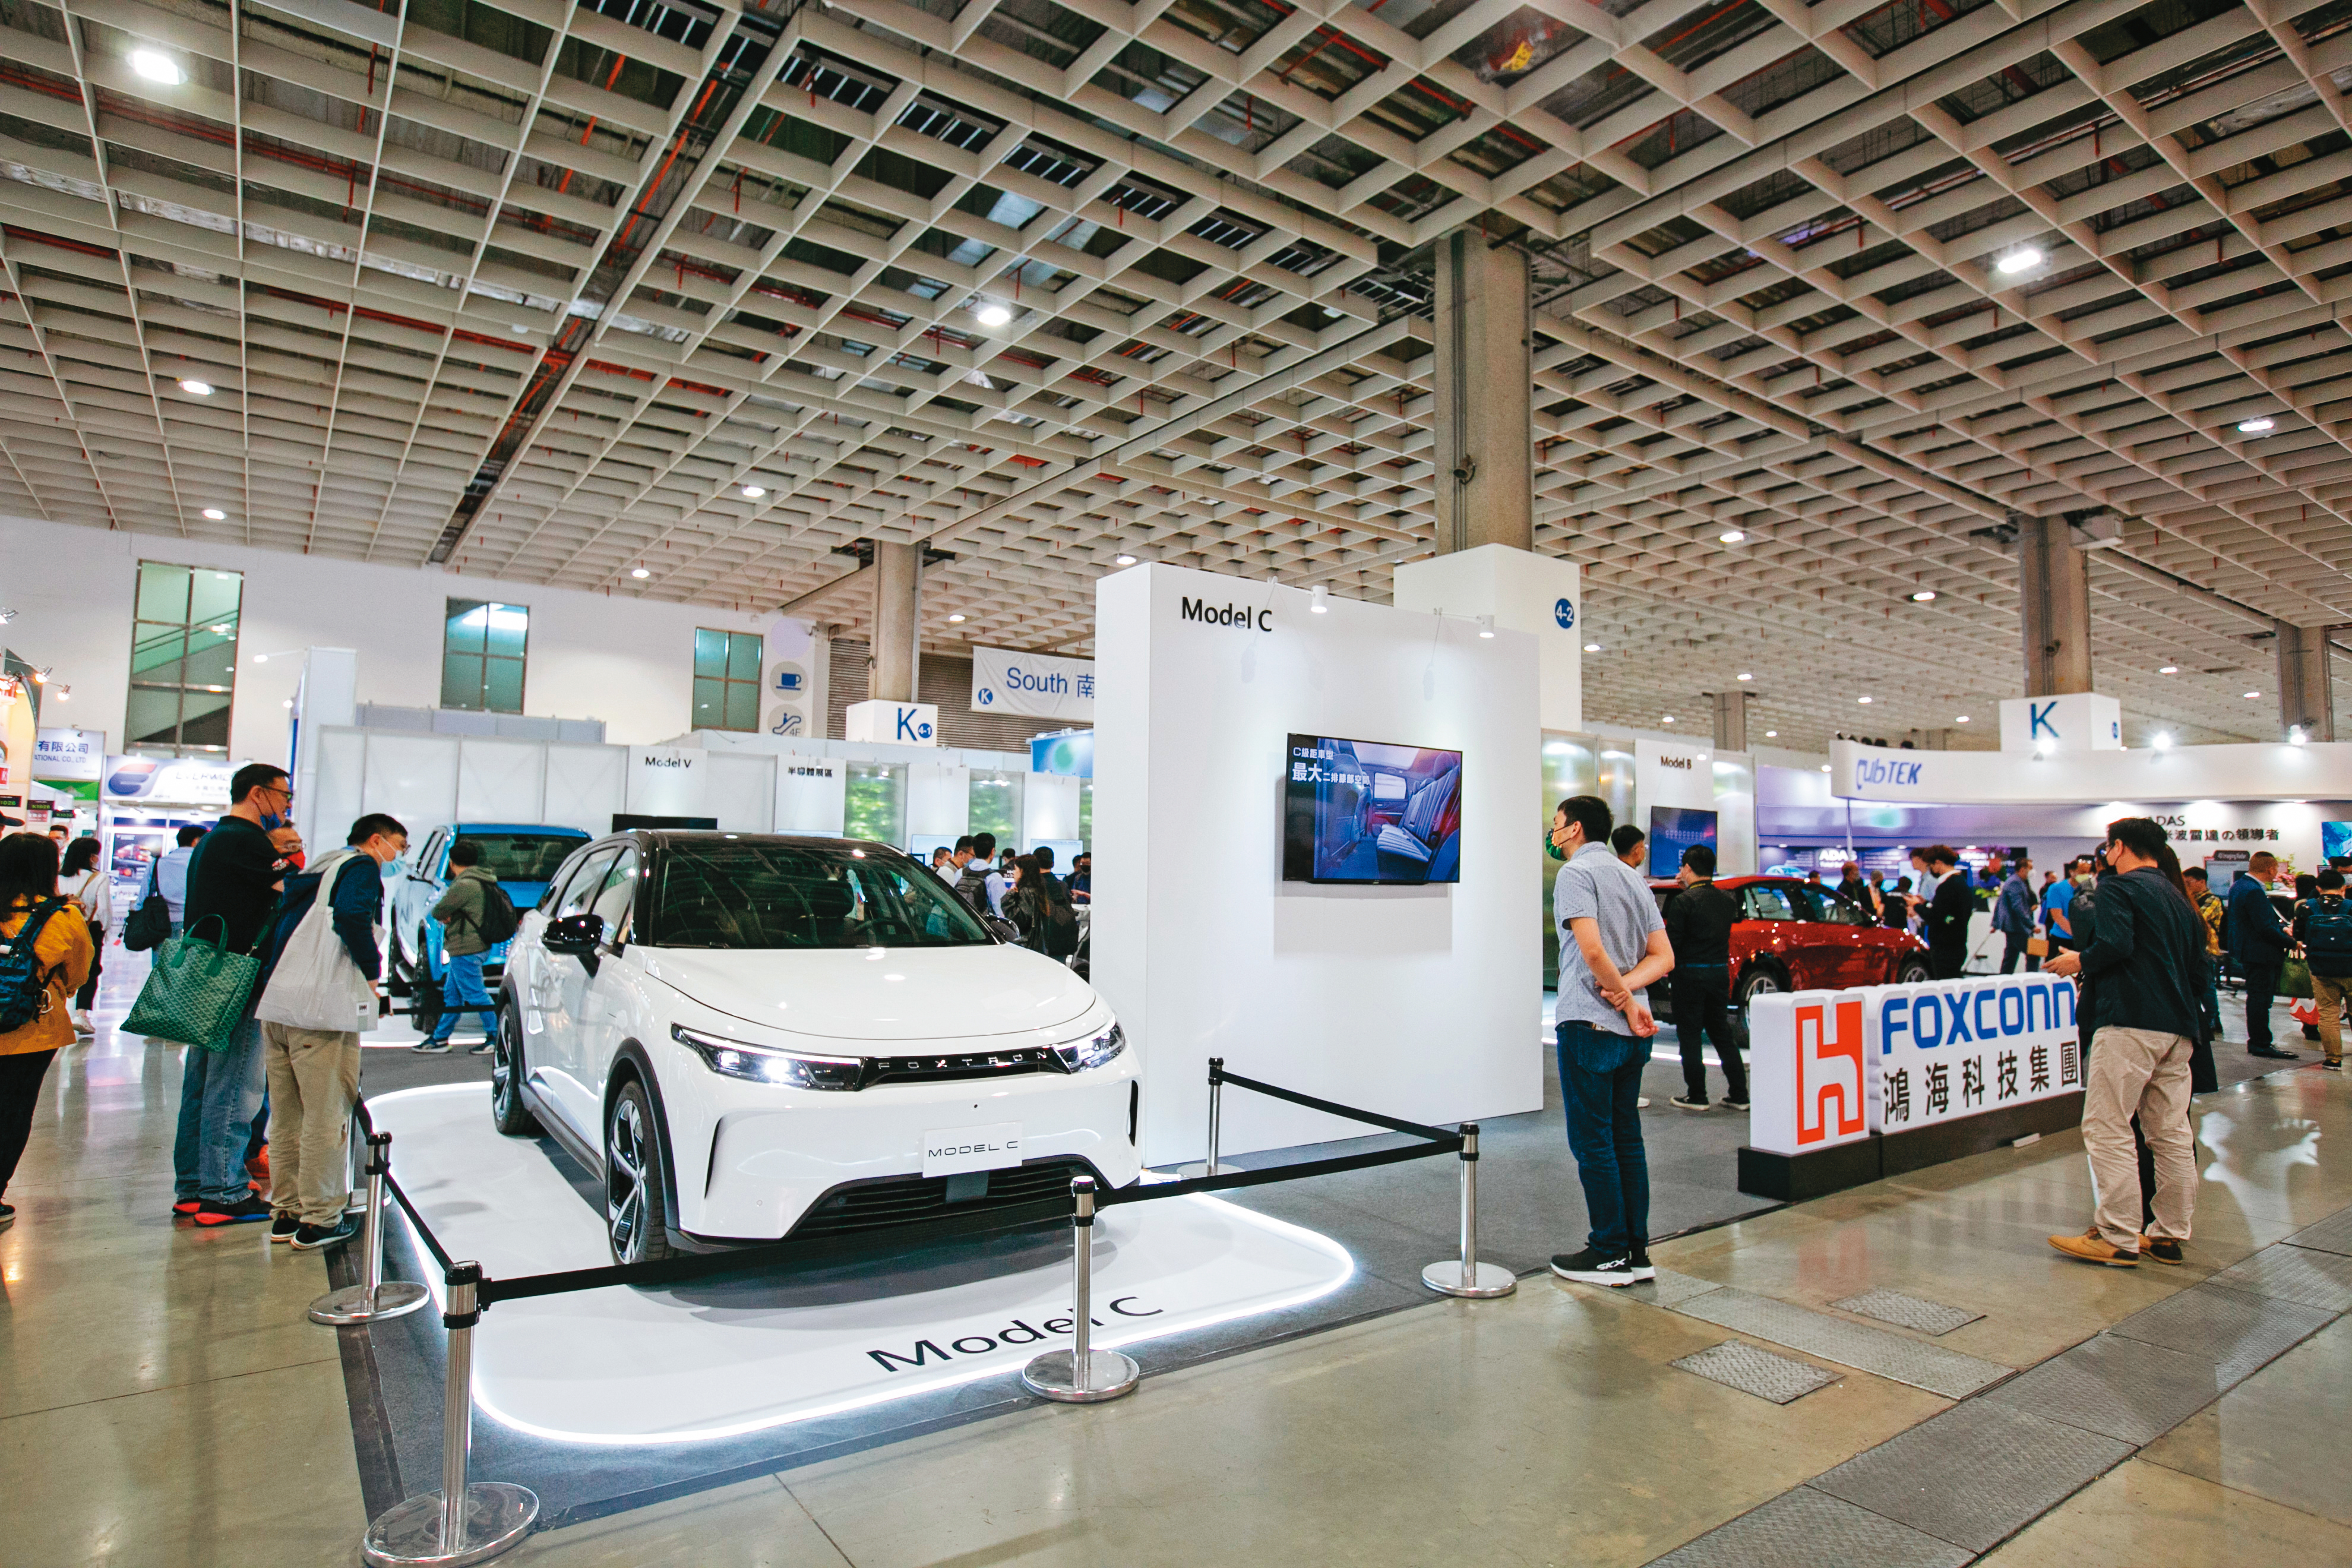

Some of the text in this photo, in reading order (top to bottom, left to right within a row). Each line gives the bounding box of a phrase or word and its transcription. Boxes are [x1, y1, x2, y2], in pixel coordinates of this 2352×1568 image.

[1182, 596, 1272, 632] Model C
[1556, 604, 1573, 622] 4-2
[1006, 667, 1095, 698] South 南
[981, 690, 991, 704] K
[897, 707, 932, 741] K 4-1
[2030, 701, 2059, 739] K
[789, 728, 801, 736] 4F
[39, 741, 88, 754] 有限公司
[645, 756, 692, 769] Model V
[1661, 755, 1692, 769] Model B
[2149, 815, 2185, 826] DAS
[878, 1051, 1047, 1069] FOXTRON
[1883, 1041, 2078, 1125] 鴻海科技集團
[928, 1140, 1019, 1158] MODEL C
[1109, 1296, 1164, 1317] C
